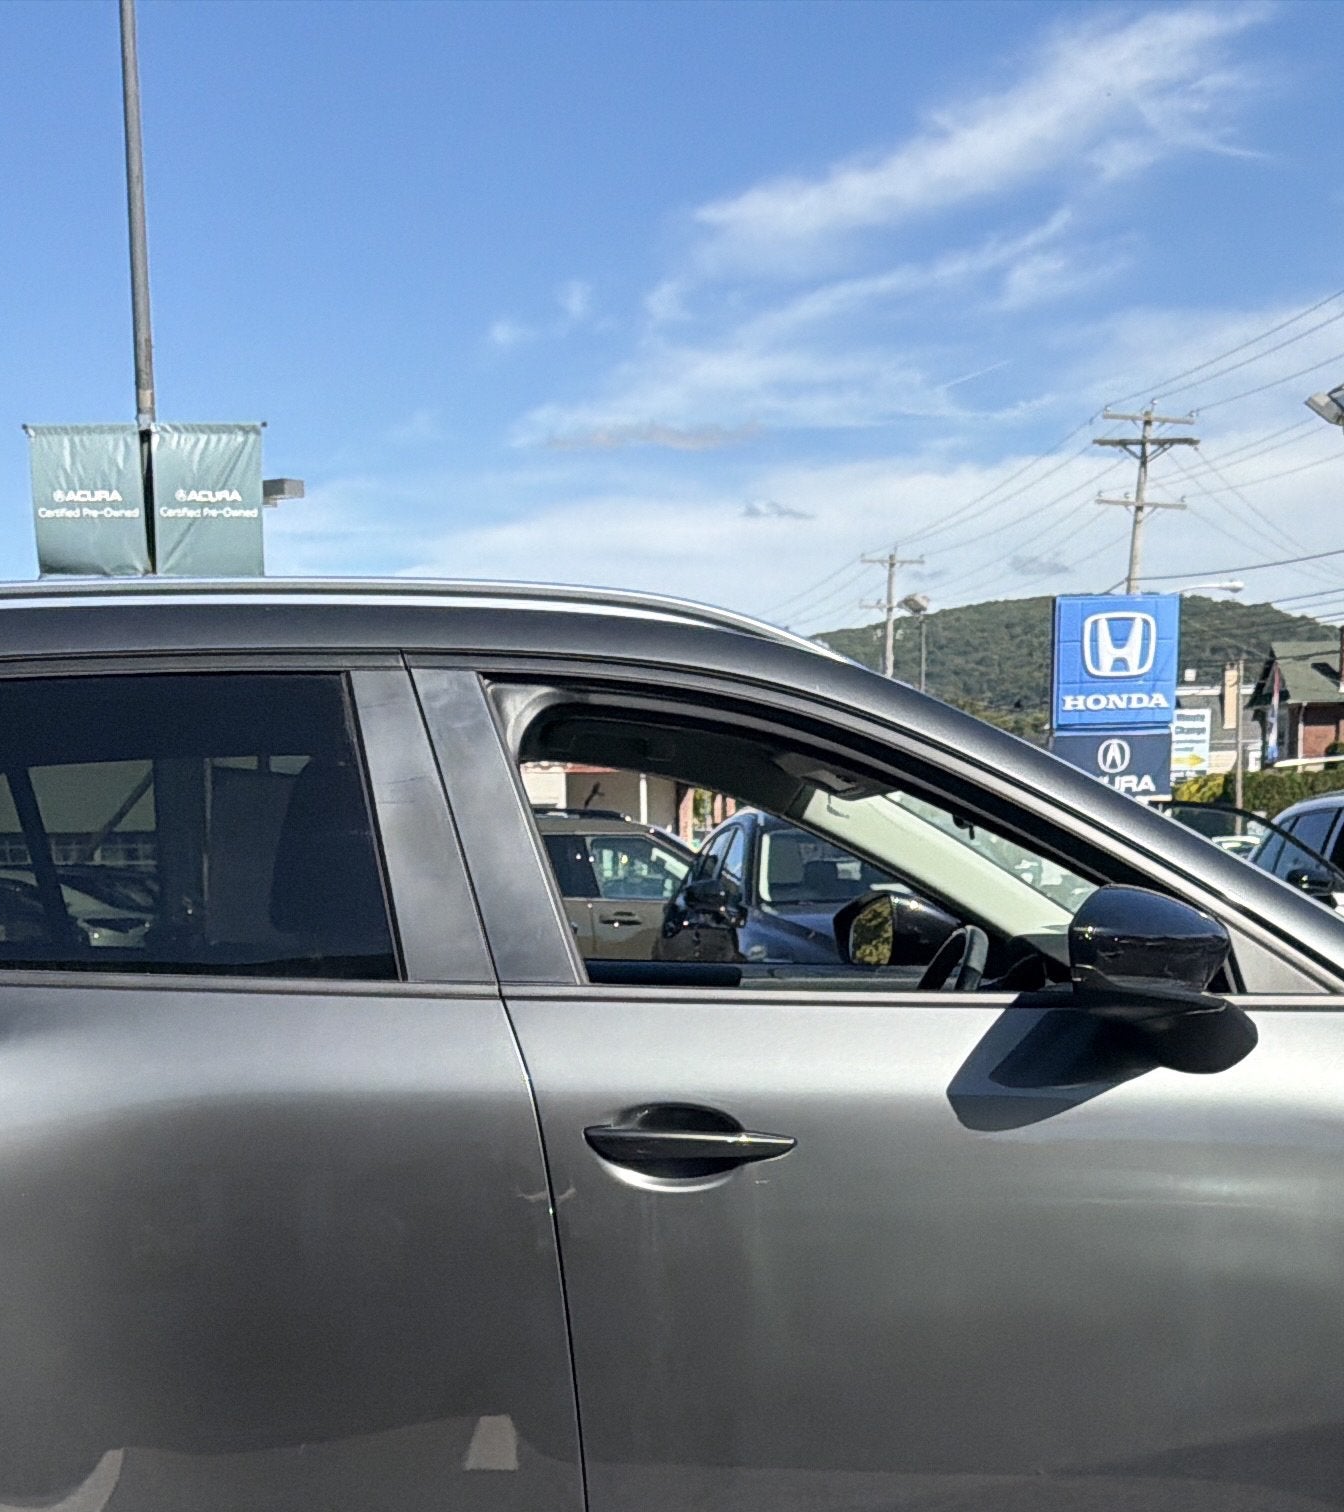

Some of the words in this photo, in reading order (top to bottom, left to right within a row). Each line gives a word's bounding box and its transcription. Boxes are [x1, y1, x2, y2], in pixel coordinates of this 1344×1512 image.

[65, 489, 123, 502] ACURA
[185, 489, 242, 502] ACURA
[38, 507, 81, 519] Certified
[82, 507, 140, 518] Pre-Owned
[159, 507, 202, 518] Certified
[203, 507, 259, 518] Pre-Owned
[1062, 693, 1169, 711] HONDA
